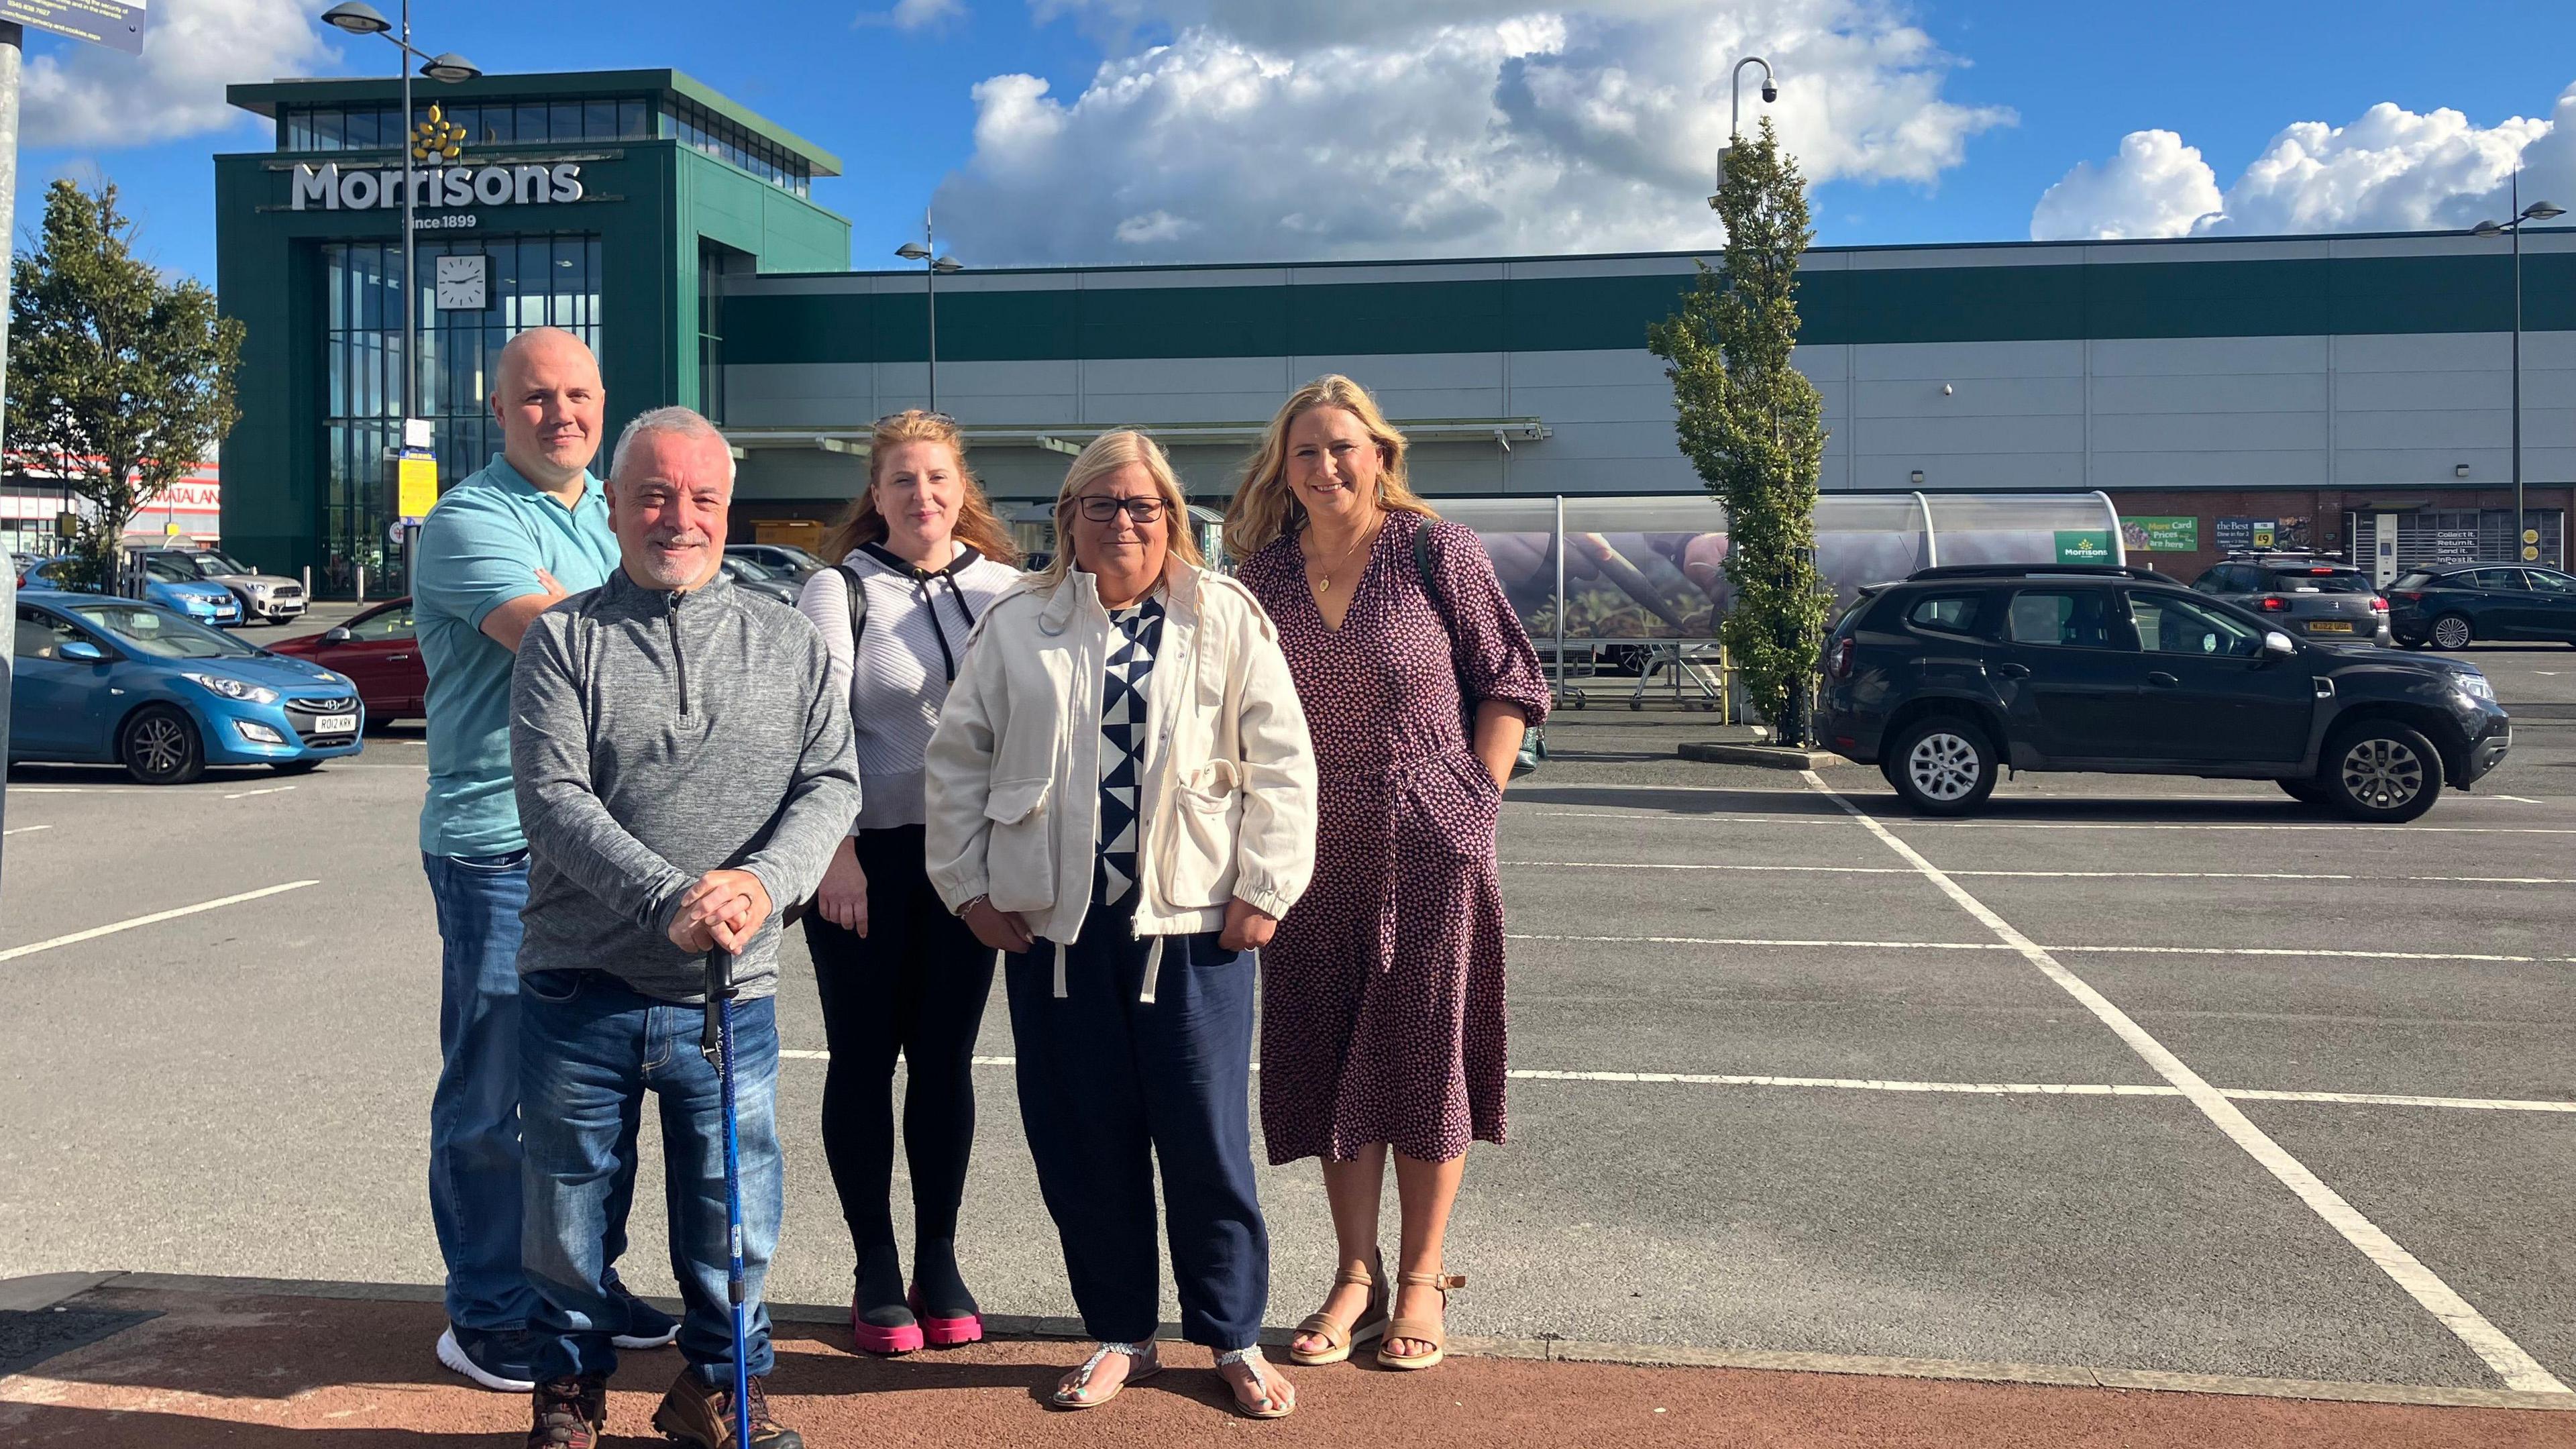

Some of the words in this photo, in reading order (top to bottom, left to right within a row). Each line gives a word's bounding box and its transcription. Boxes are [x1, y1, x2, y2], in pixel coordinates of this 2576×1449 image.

[292, 163, 582, 211] Morrisons
[442, 215, 476, 228] 1899
[2172, 520, 2192, 529] Card
[2217, 521, 2231, 530] the
[2231, 522, 2249, 530] Best
[2153, 531, 2178, 539] Prices
[2259, 535, 2269, 544] £9
[2165, 539, 2184, 549] here
[339, 718, 352, 728] KRK
